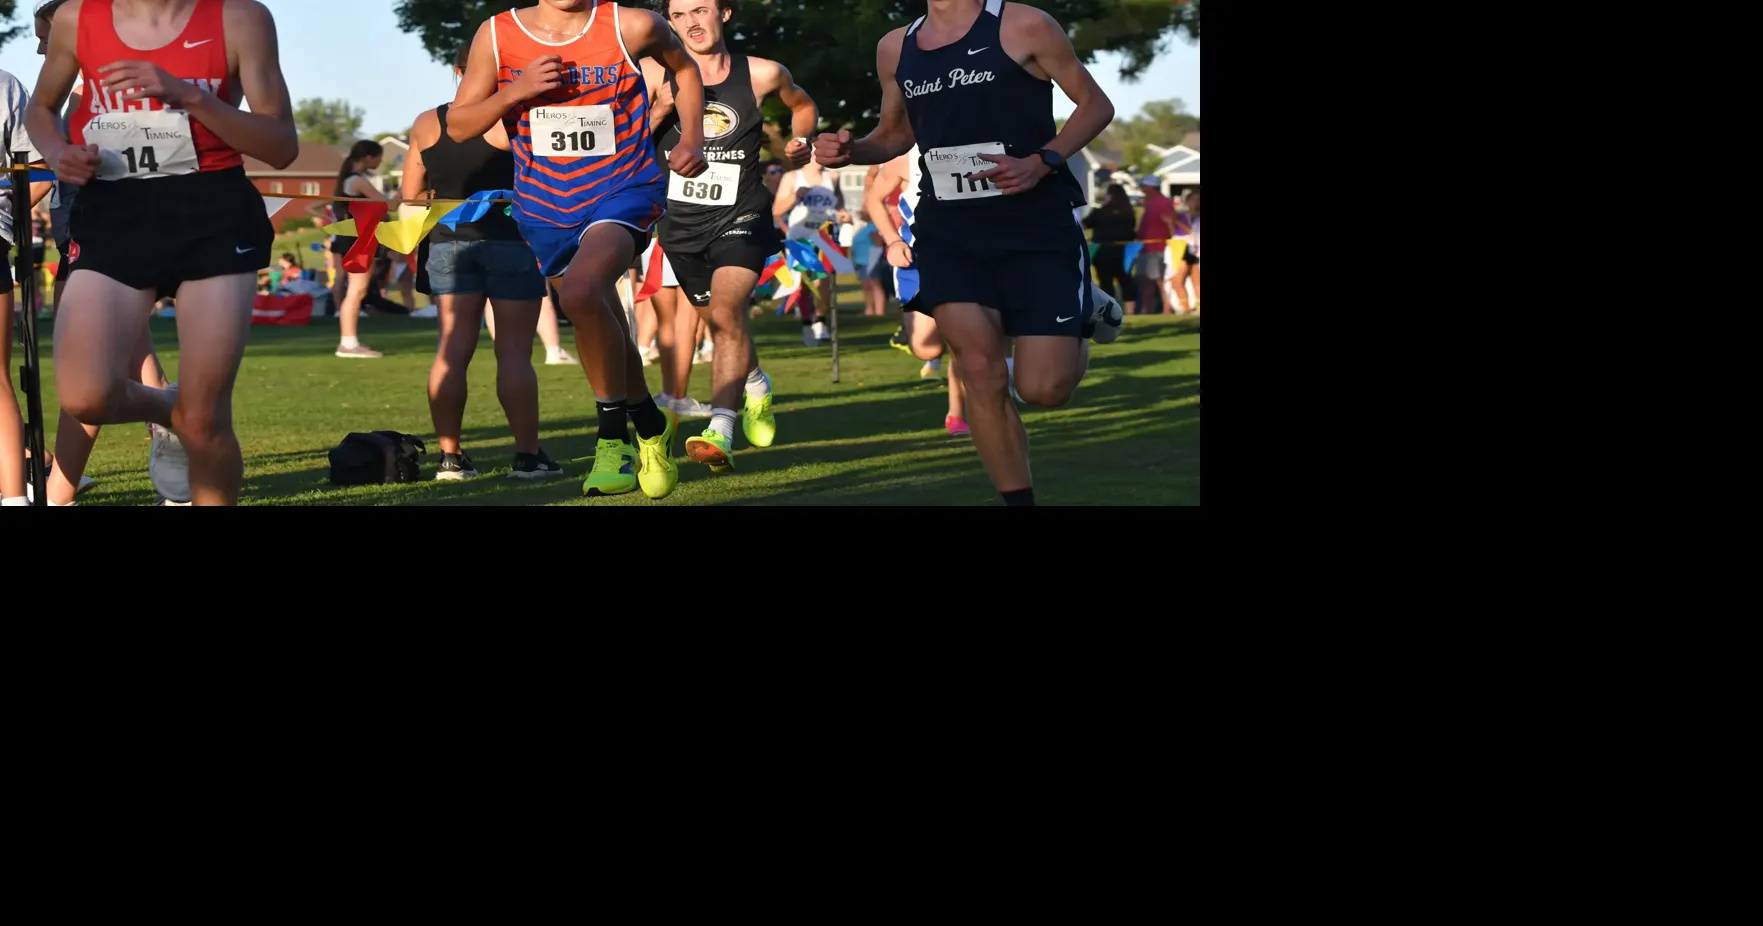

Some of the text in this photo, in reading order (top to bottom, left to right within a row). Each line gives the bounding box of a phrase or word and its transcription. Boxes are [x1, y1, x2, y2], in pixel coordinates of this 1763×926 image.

[903, 68, 995, 99] Saint Peter
[577, 117, 607, 127] TIMING
[140, 127, 182, 140] TIMING
[550, 130, 596, 151] 310
[121, 146, 159, 173] 14
[682, 180, 723, 201] 630
